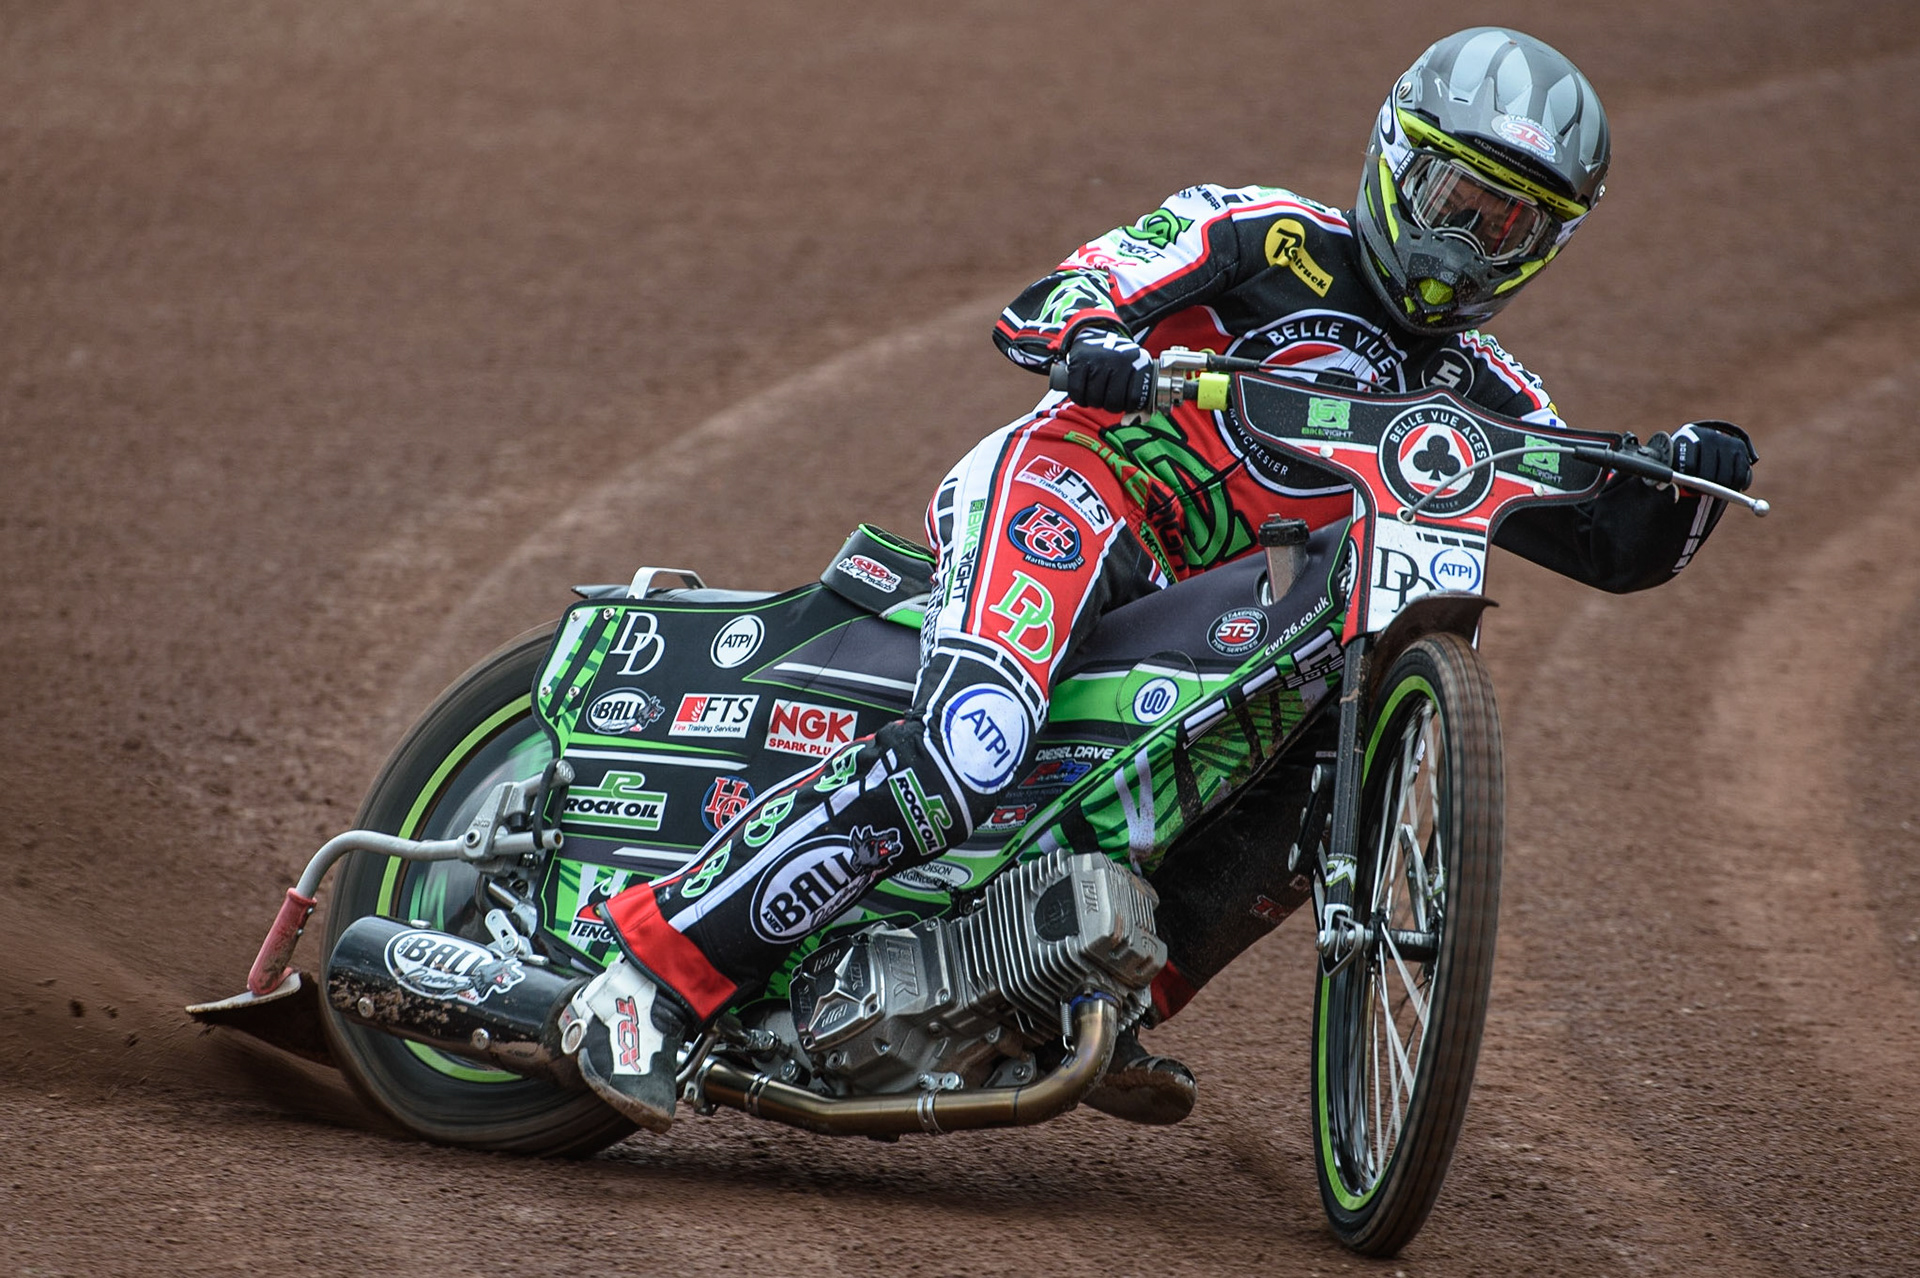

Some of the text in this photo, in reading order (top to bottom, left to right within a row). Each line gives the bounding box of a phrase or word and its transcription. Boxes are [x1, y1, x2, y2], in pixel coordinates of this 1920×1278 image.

[1506, 122, 1551, 151] STS
[1266, 320, 1397, 374] BELLE VUE
[1389, 410, 1487, 458] BELLE VUE ACES
[1038, 478, 1069, 499] Training
[1068, 498, 1097, 527] Services
[1054, 468, 1110, 525] FTS
[1024, 553, 1057, 569] Hartburn
[1438, 562, 1473, 580] ATPI
[1217, 622, 1257, 638] STS
[1264, 595, 1330, 657] cwr26.co.uk
[609, 611, 666, 676] DD
[721, 633, 754, 650] ATPI
[1225, 639, 1259, 653] SERVICES
[700, 697, 754, 723] FTS
[770, 704, 854, 743] NGK
[673, 723, 741, 733] Fire Training Services
[961, 708, 1011, 769] ATPI
[768, 737, 832, 755] SPARK PLU
[1035, 745, 1115, 762] DIESEL DAVE
[564, 798, 659, 819] ROCK OIL
[896, 777, 940, 851] ROCK OIL
[616, 995, 641, 1073] TCX
